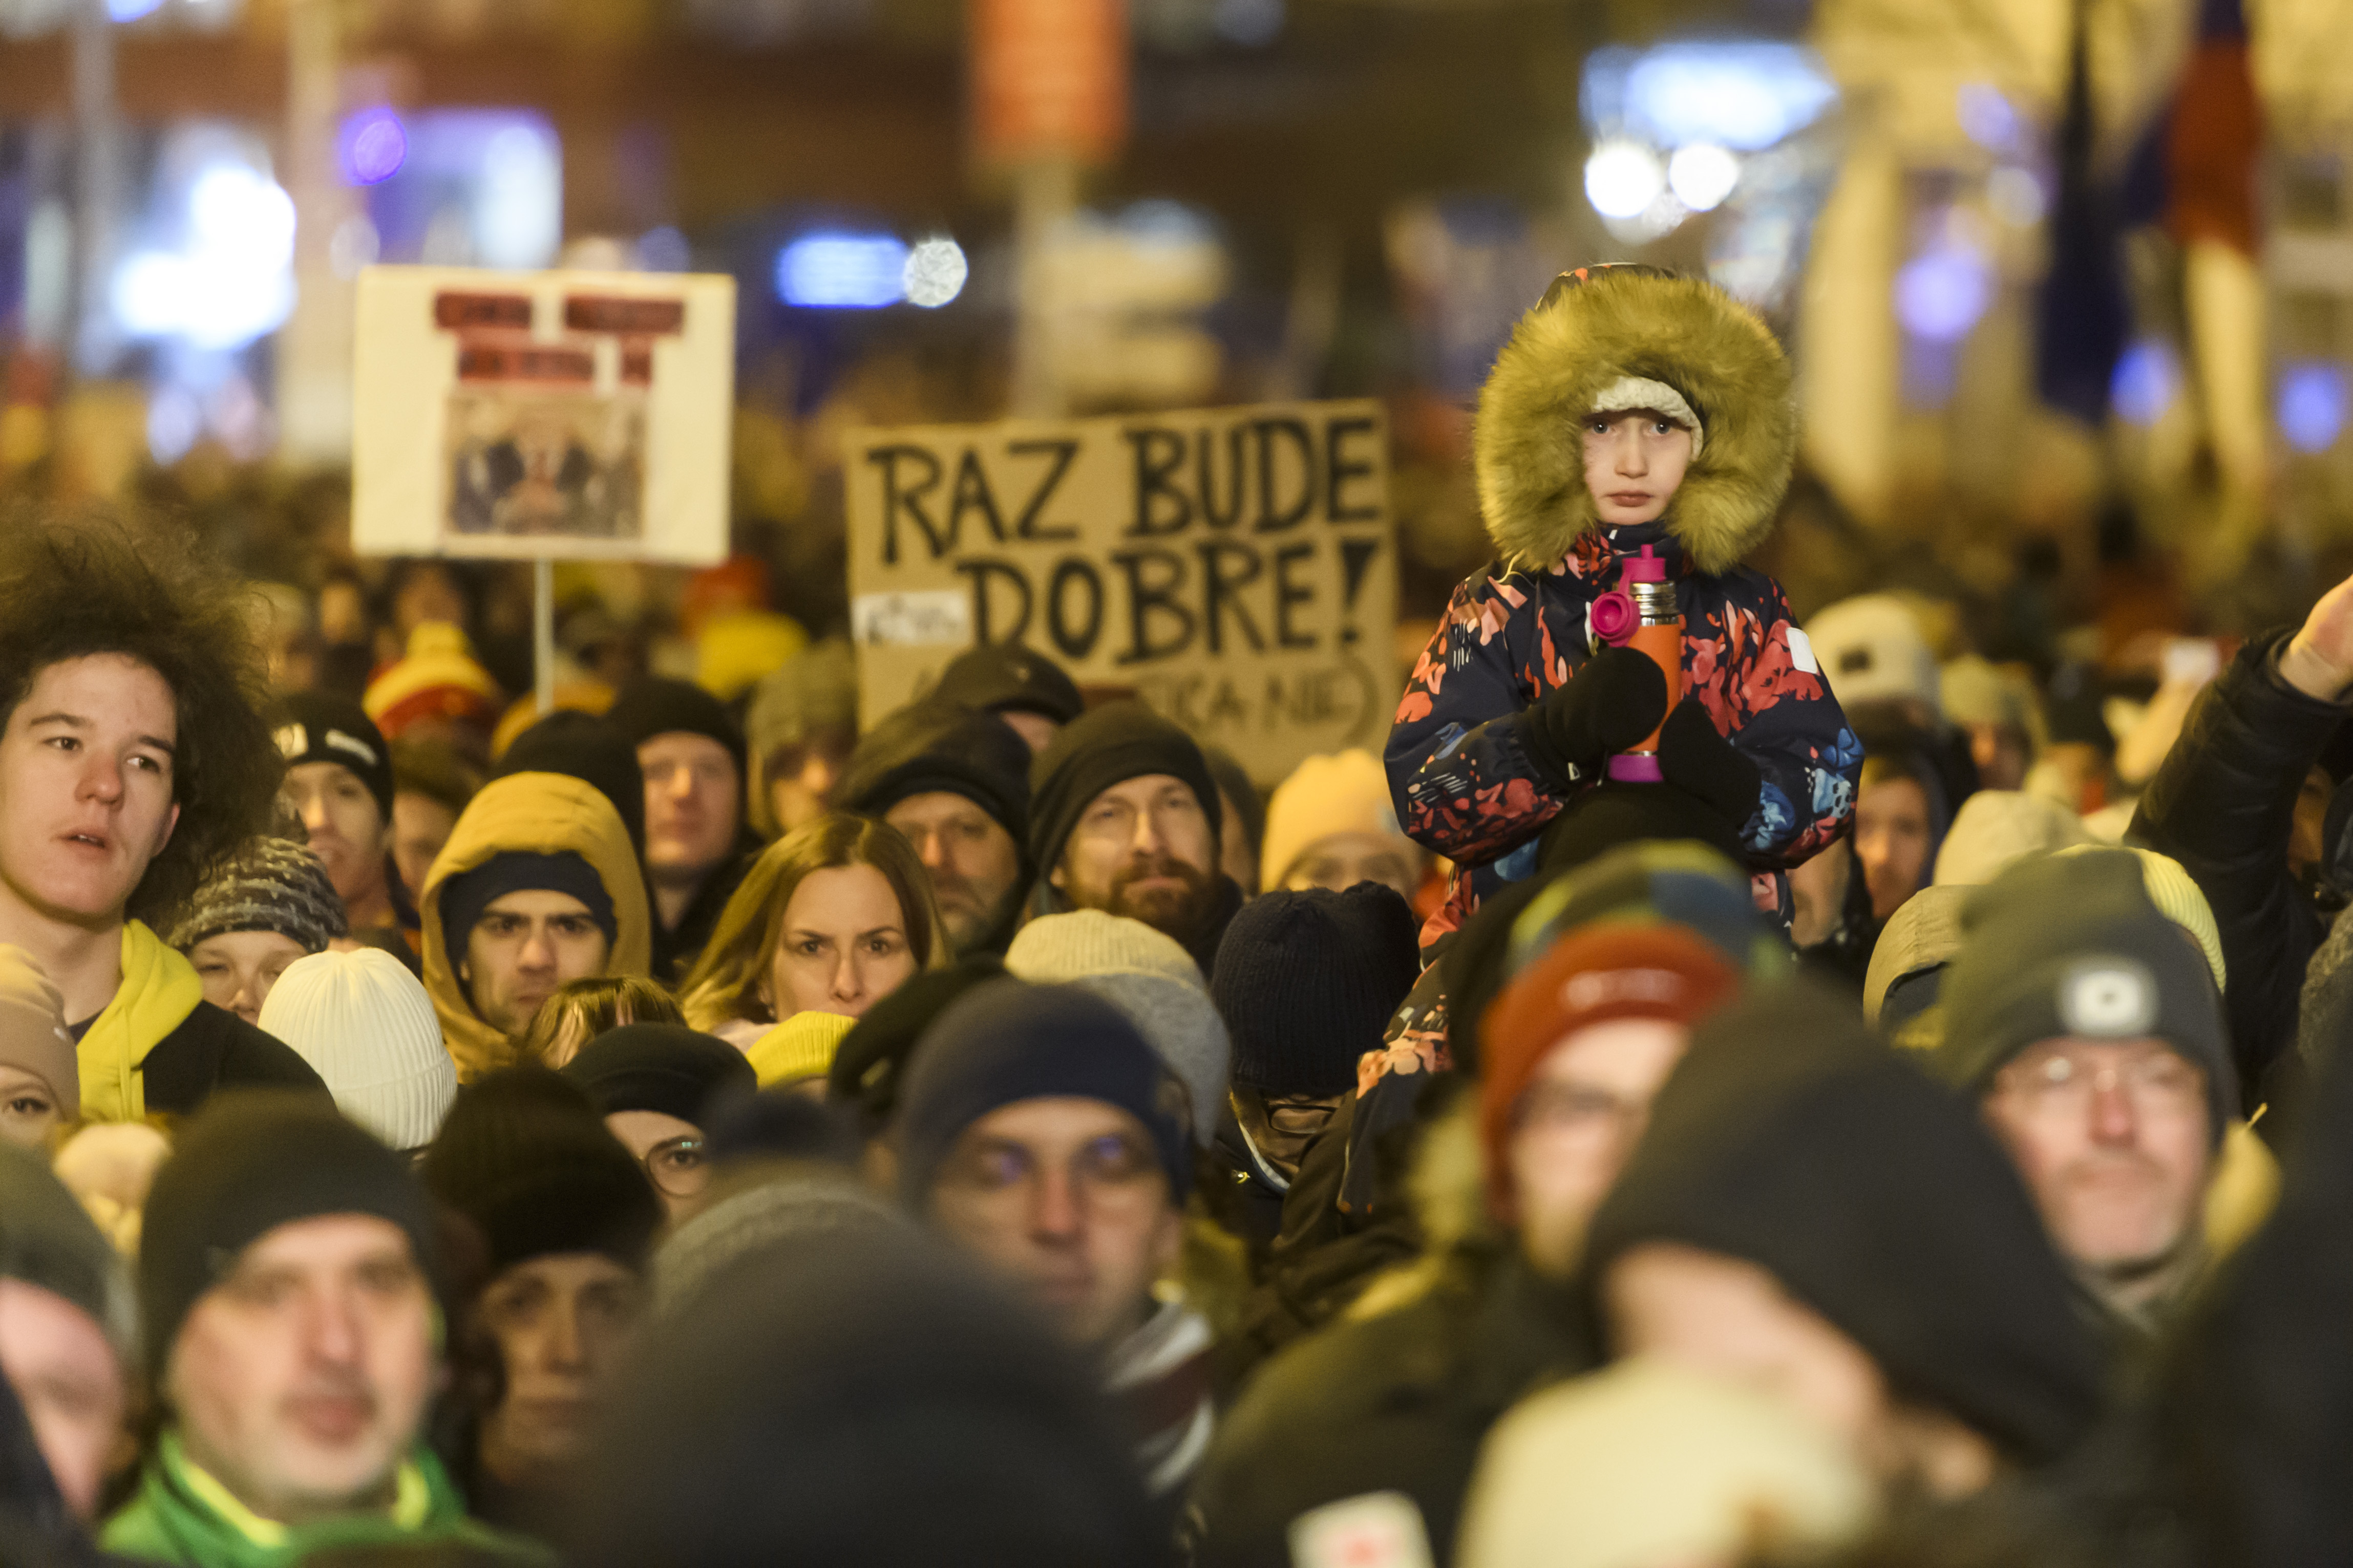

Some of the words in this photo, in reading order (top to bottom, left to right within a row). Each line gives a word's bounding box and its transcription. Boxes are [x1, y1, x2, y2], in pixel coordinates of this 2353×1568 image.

[865, 439, 1082, 566] RAZ
[1120, 417, 1379, 538] BUDE
[952, 539, 1382, 665] DOBRE!
